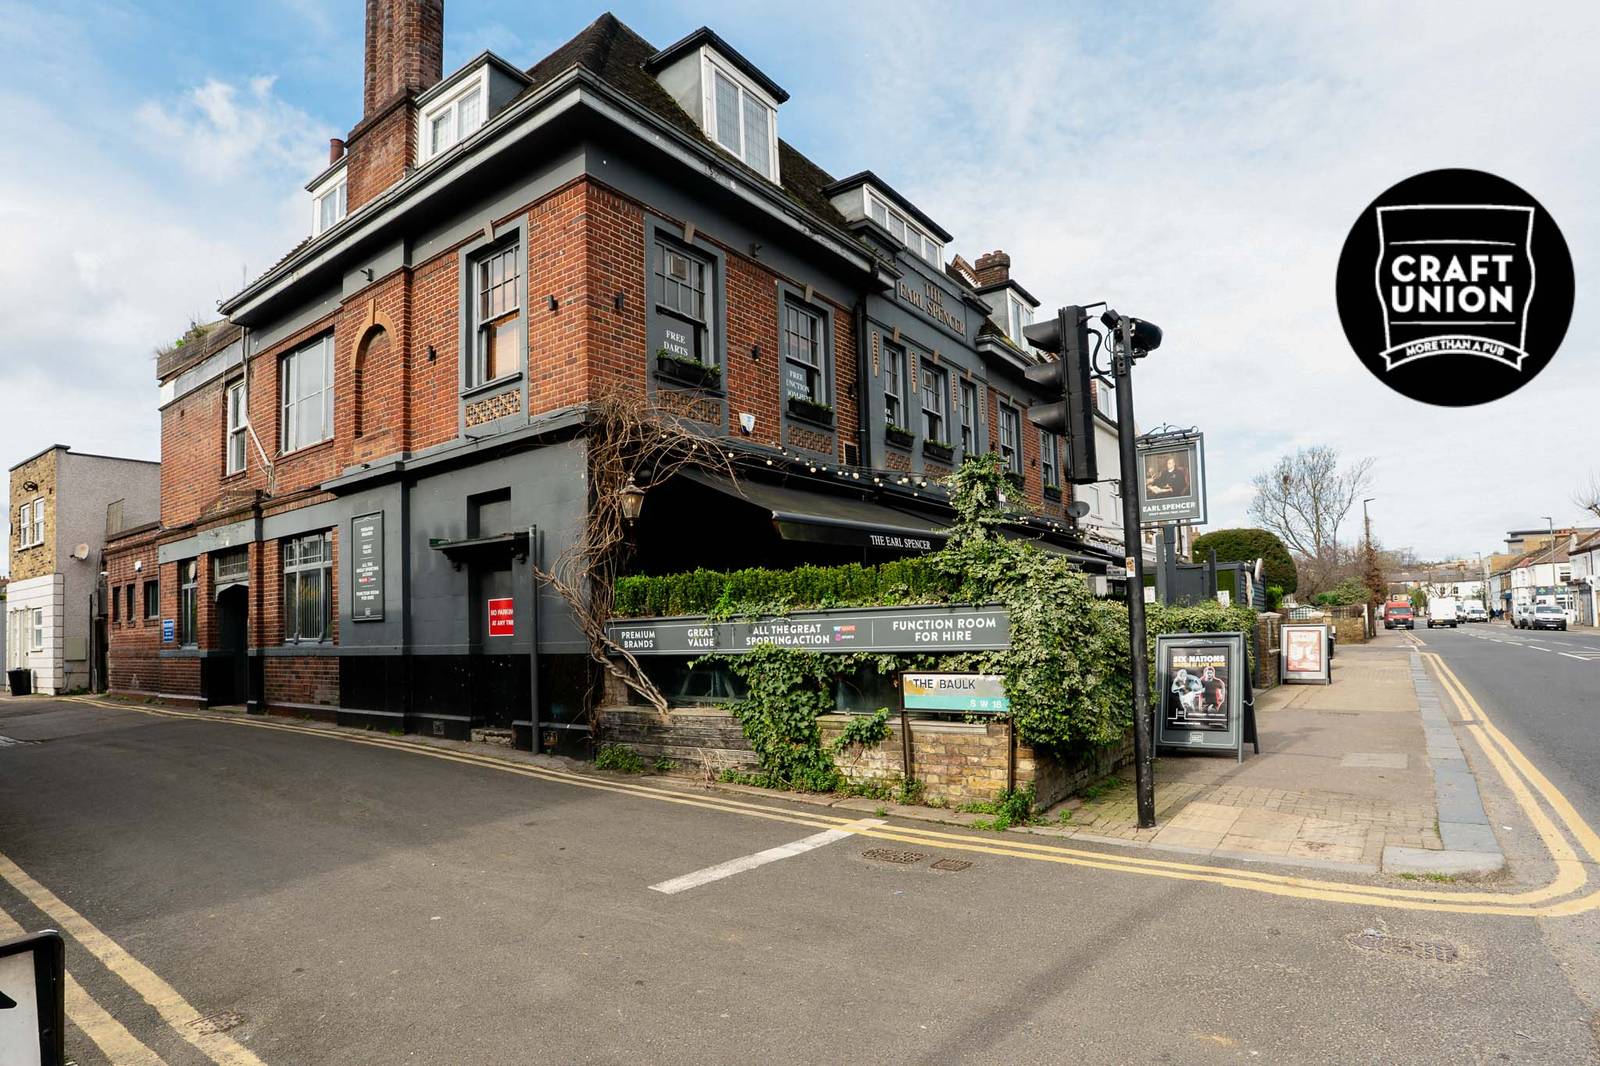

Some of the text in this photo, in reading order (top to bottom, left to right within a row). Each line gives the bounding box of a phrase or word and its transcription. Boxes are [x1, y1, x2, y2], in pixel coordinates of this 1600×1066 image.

[926, 301, 966, 336] SPENCER
[666, 329, 686, 344] FREE
[663, 341, 689, 356] DARTS
[1161, 501, 1196, 511] SPENCER
[870, 535, 931, 550] THE EARL SPENCER
[752, 624, 821, 635] ALL THE GREAT
[892, 617, 996, 631] FUNCTION ROOM
[621, 630, 655, 639] PREMIUM
[687, 628, 714, 637] GREAT
[915, 630, 972, 642] FOR HIRE
[624, 640, 654, 648] BRANDS
[687, 638, 714, 647] VALUE
[1172, 655, 1188, 663] SIX
[913, 678, 976, 690] THE BAULK
